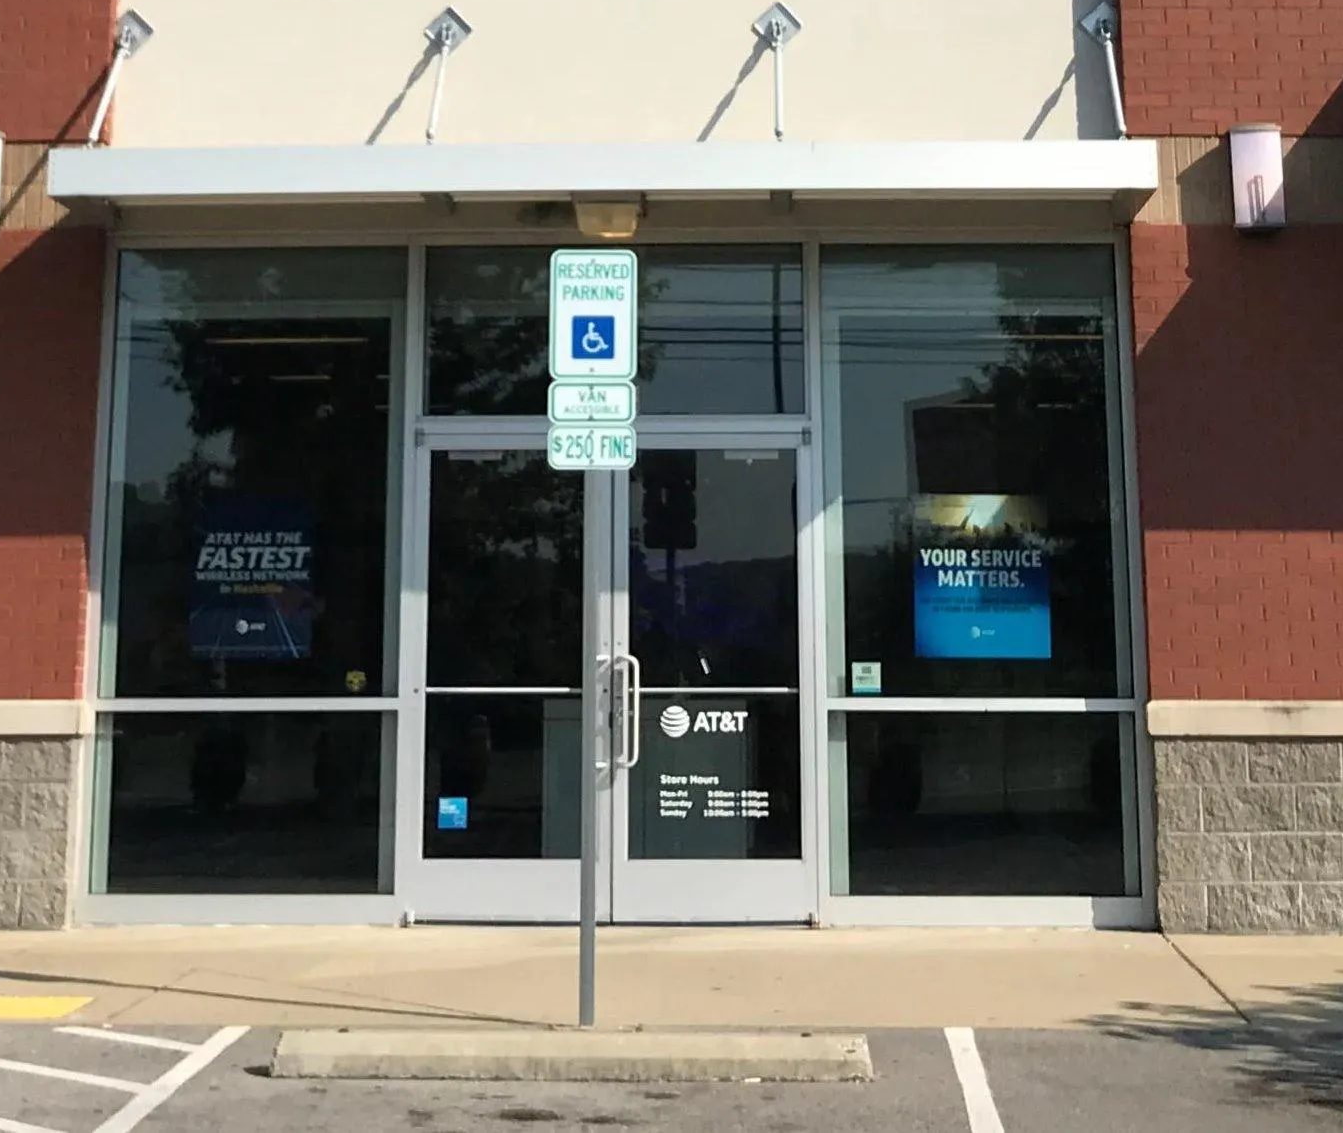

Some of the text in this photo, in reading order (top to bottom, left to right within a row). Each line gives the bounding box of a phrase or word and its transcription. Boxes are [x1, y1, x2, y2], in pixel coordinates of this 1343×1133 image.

[558, 263, 629, 279] RESERVED
[562, 285, 625, 301] PARKING
[578, 390, 607, 403] VAN
[563, 405, 621, 415] ACCESSIBLE
[600, 435, 632, 459] FINE
[243, 530, 272, 545] HAS
[275, 531, 303, 544] THE
[196, 546, 311, 569] FASTEST
[920, 548, 1042, 568] YOUR SERVICE
[937, 569, 1026, 588] MATTERS.
[693, 711, 748, 732] AT&T
[659, 774, 719, 785] Store Hours
[659, 799, 693, 809] Saturday
[659, 809, 687, 818] Sunday
